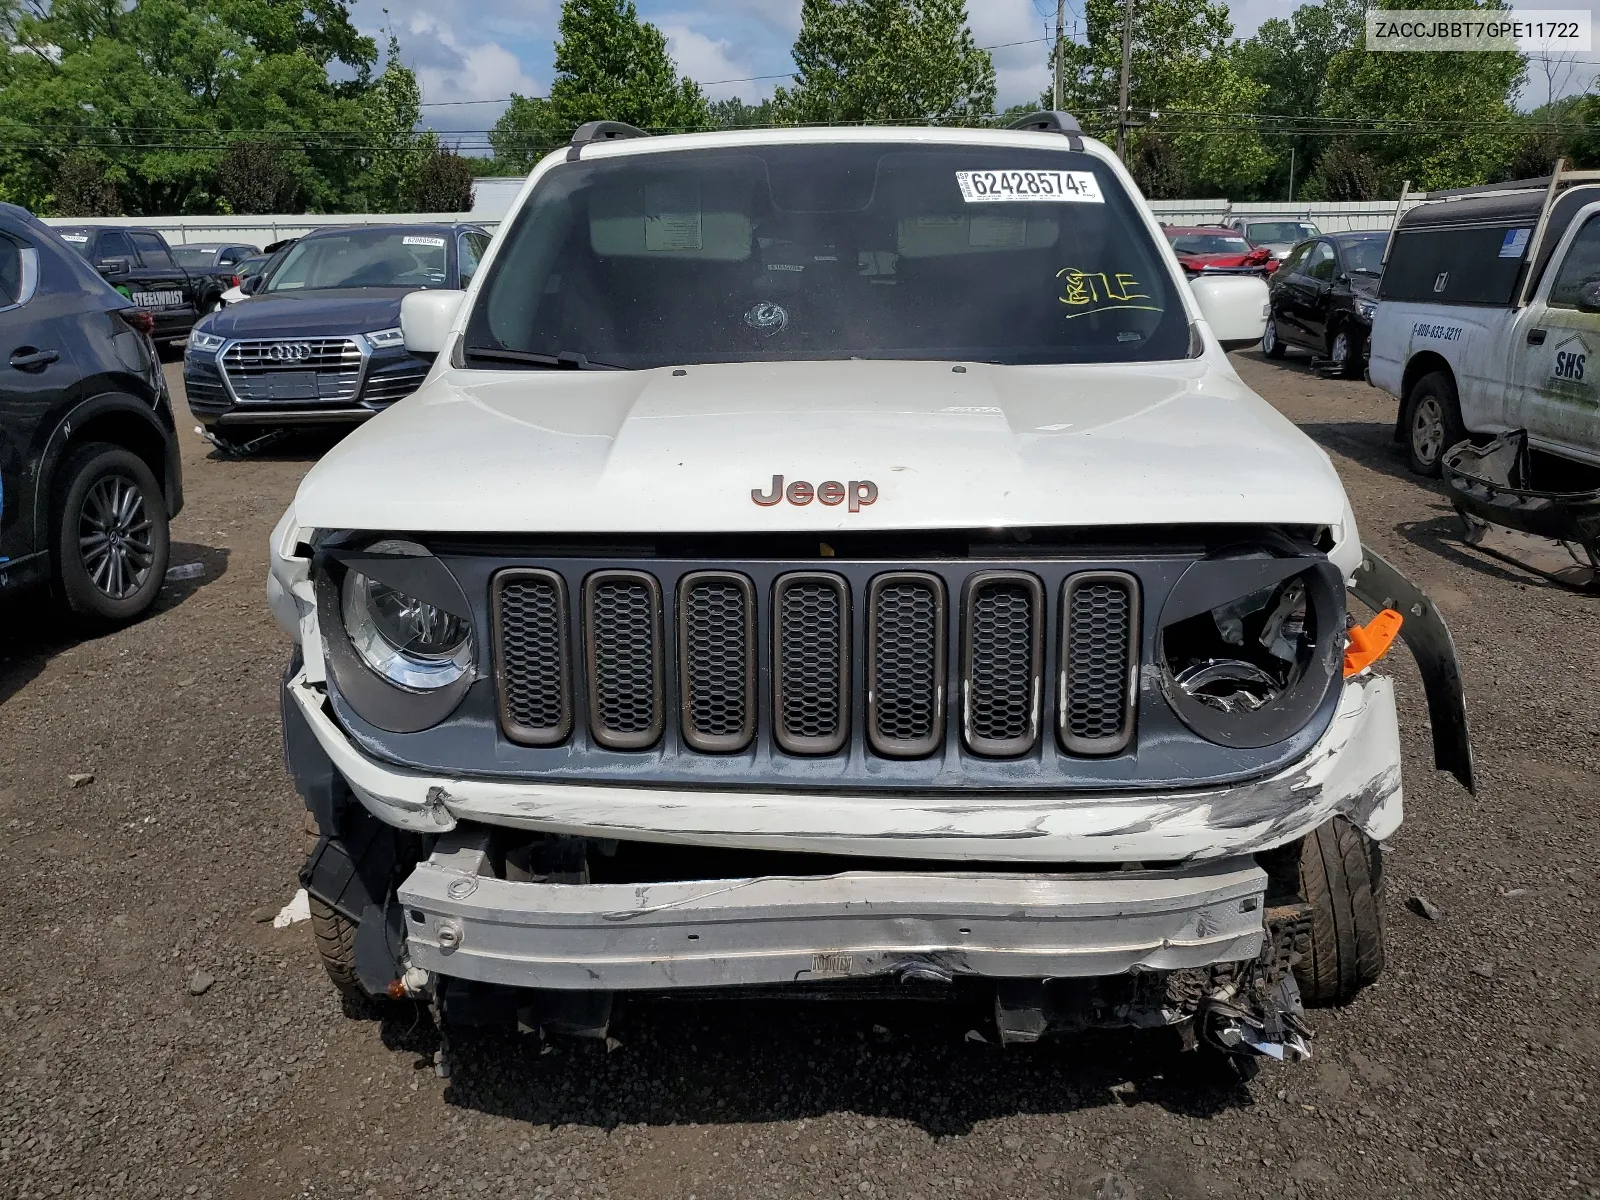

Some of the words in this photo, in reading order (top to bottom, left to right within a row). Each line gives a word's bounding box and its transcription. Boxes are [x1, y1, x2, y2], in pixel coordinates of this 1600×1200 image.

[971, 172, 1079, 195] 62428574
[132, 290, 183, 307] STEELWRIST
[1413, 322, 1463, 341] 1-800-833-3211
[1555, 351, 1586, 380] SHS
[751, 475, 879, 513] Jeep
